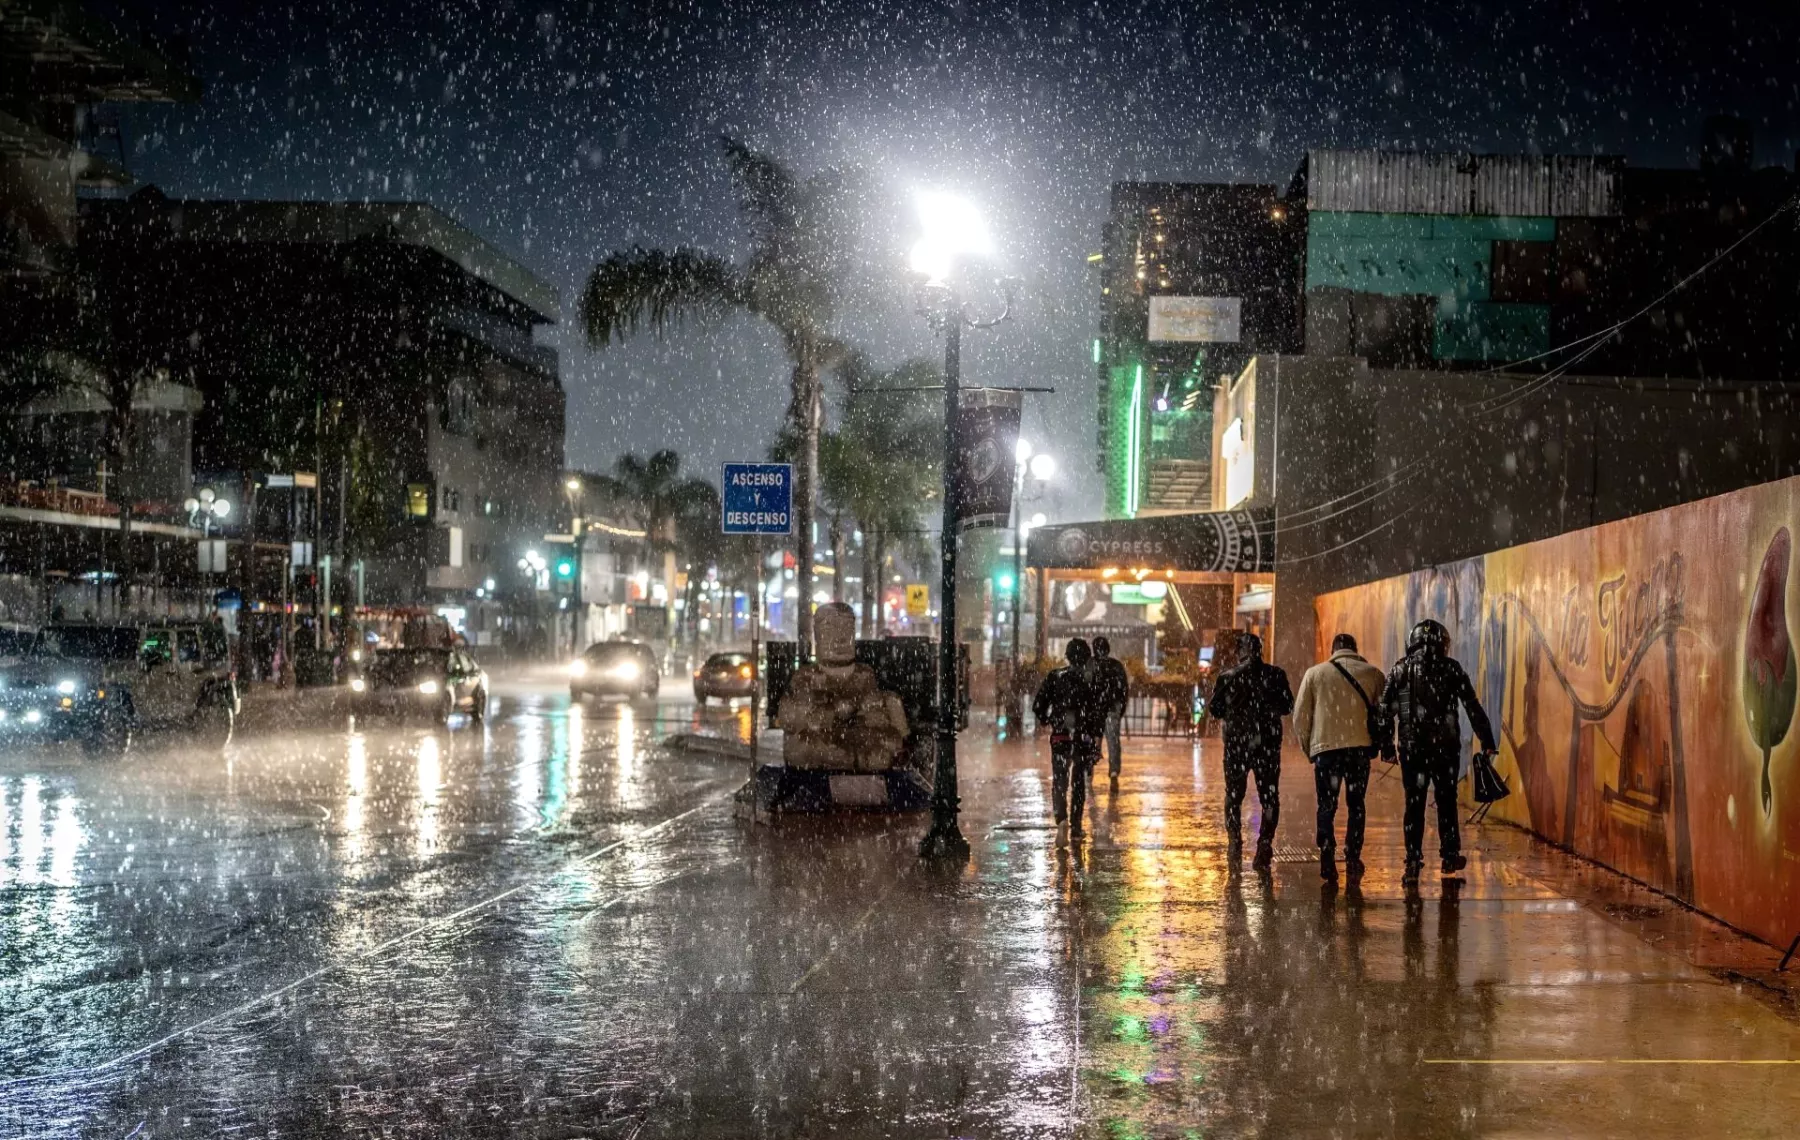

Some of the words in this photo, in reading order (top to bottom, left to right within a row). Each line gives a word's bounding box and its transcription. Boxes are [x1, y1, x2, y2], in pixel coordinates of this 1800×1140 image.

[732, 473, 783, 486] ASCENSO
[754, 493, 761, 506] Y
[727, 512, 787, 525] DESCENSO
[1089, 540, 1163, 554] CYPRESS
